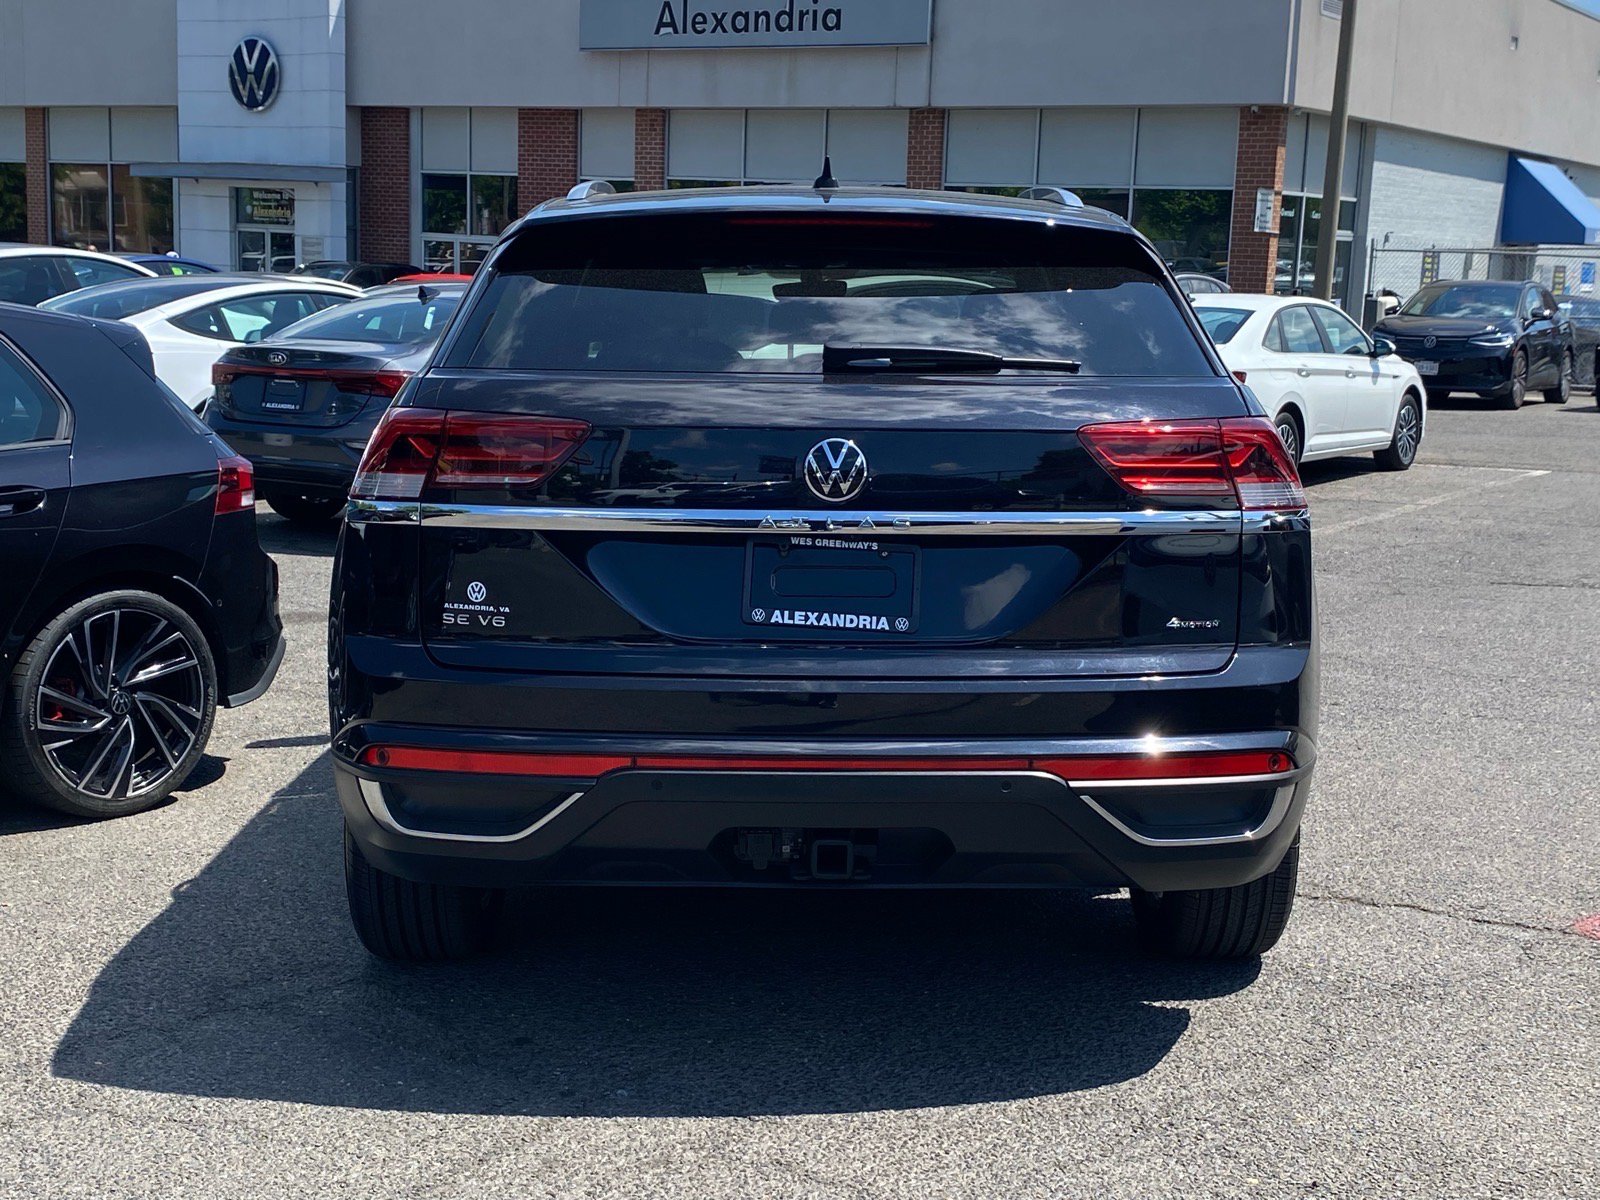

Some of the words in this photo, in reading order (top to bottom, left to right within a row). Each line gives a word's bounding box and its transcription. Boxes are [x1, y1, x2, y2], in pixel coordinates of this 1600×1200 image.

[654, 0, 842, 35] Alexandria
[253, 206, 291, 217] Alexandria
[790, 536, 812, 546] WES
[815, 538, 879, 550] GREENWAY'S
[444, 603, 497, 613] ALEXANDRIA,
[442, 613, 469, 625] SE
[478, 614, 506, 627] V6
[770, 609, 890, 631] ALEXANDRIA
